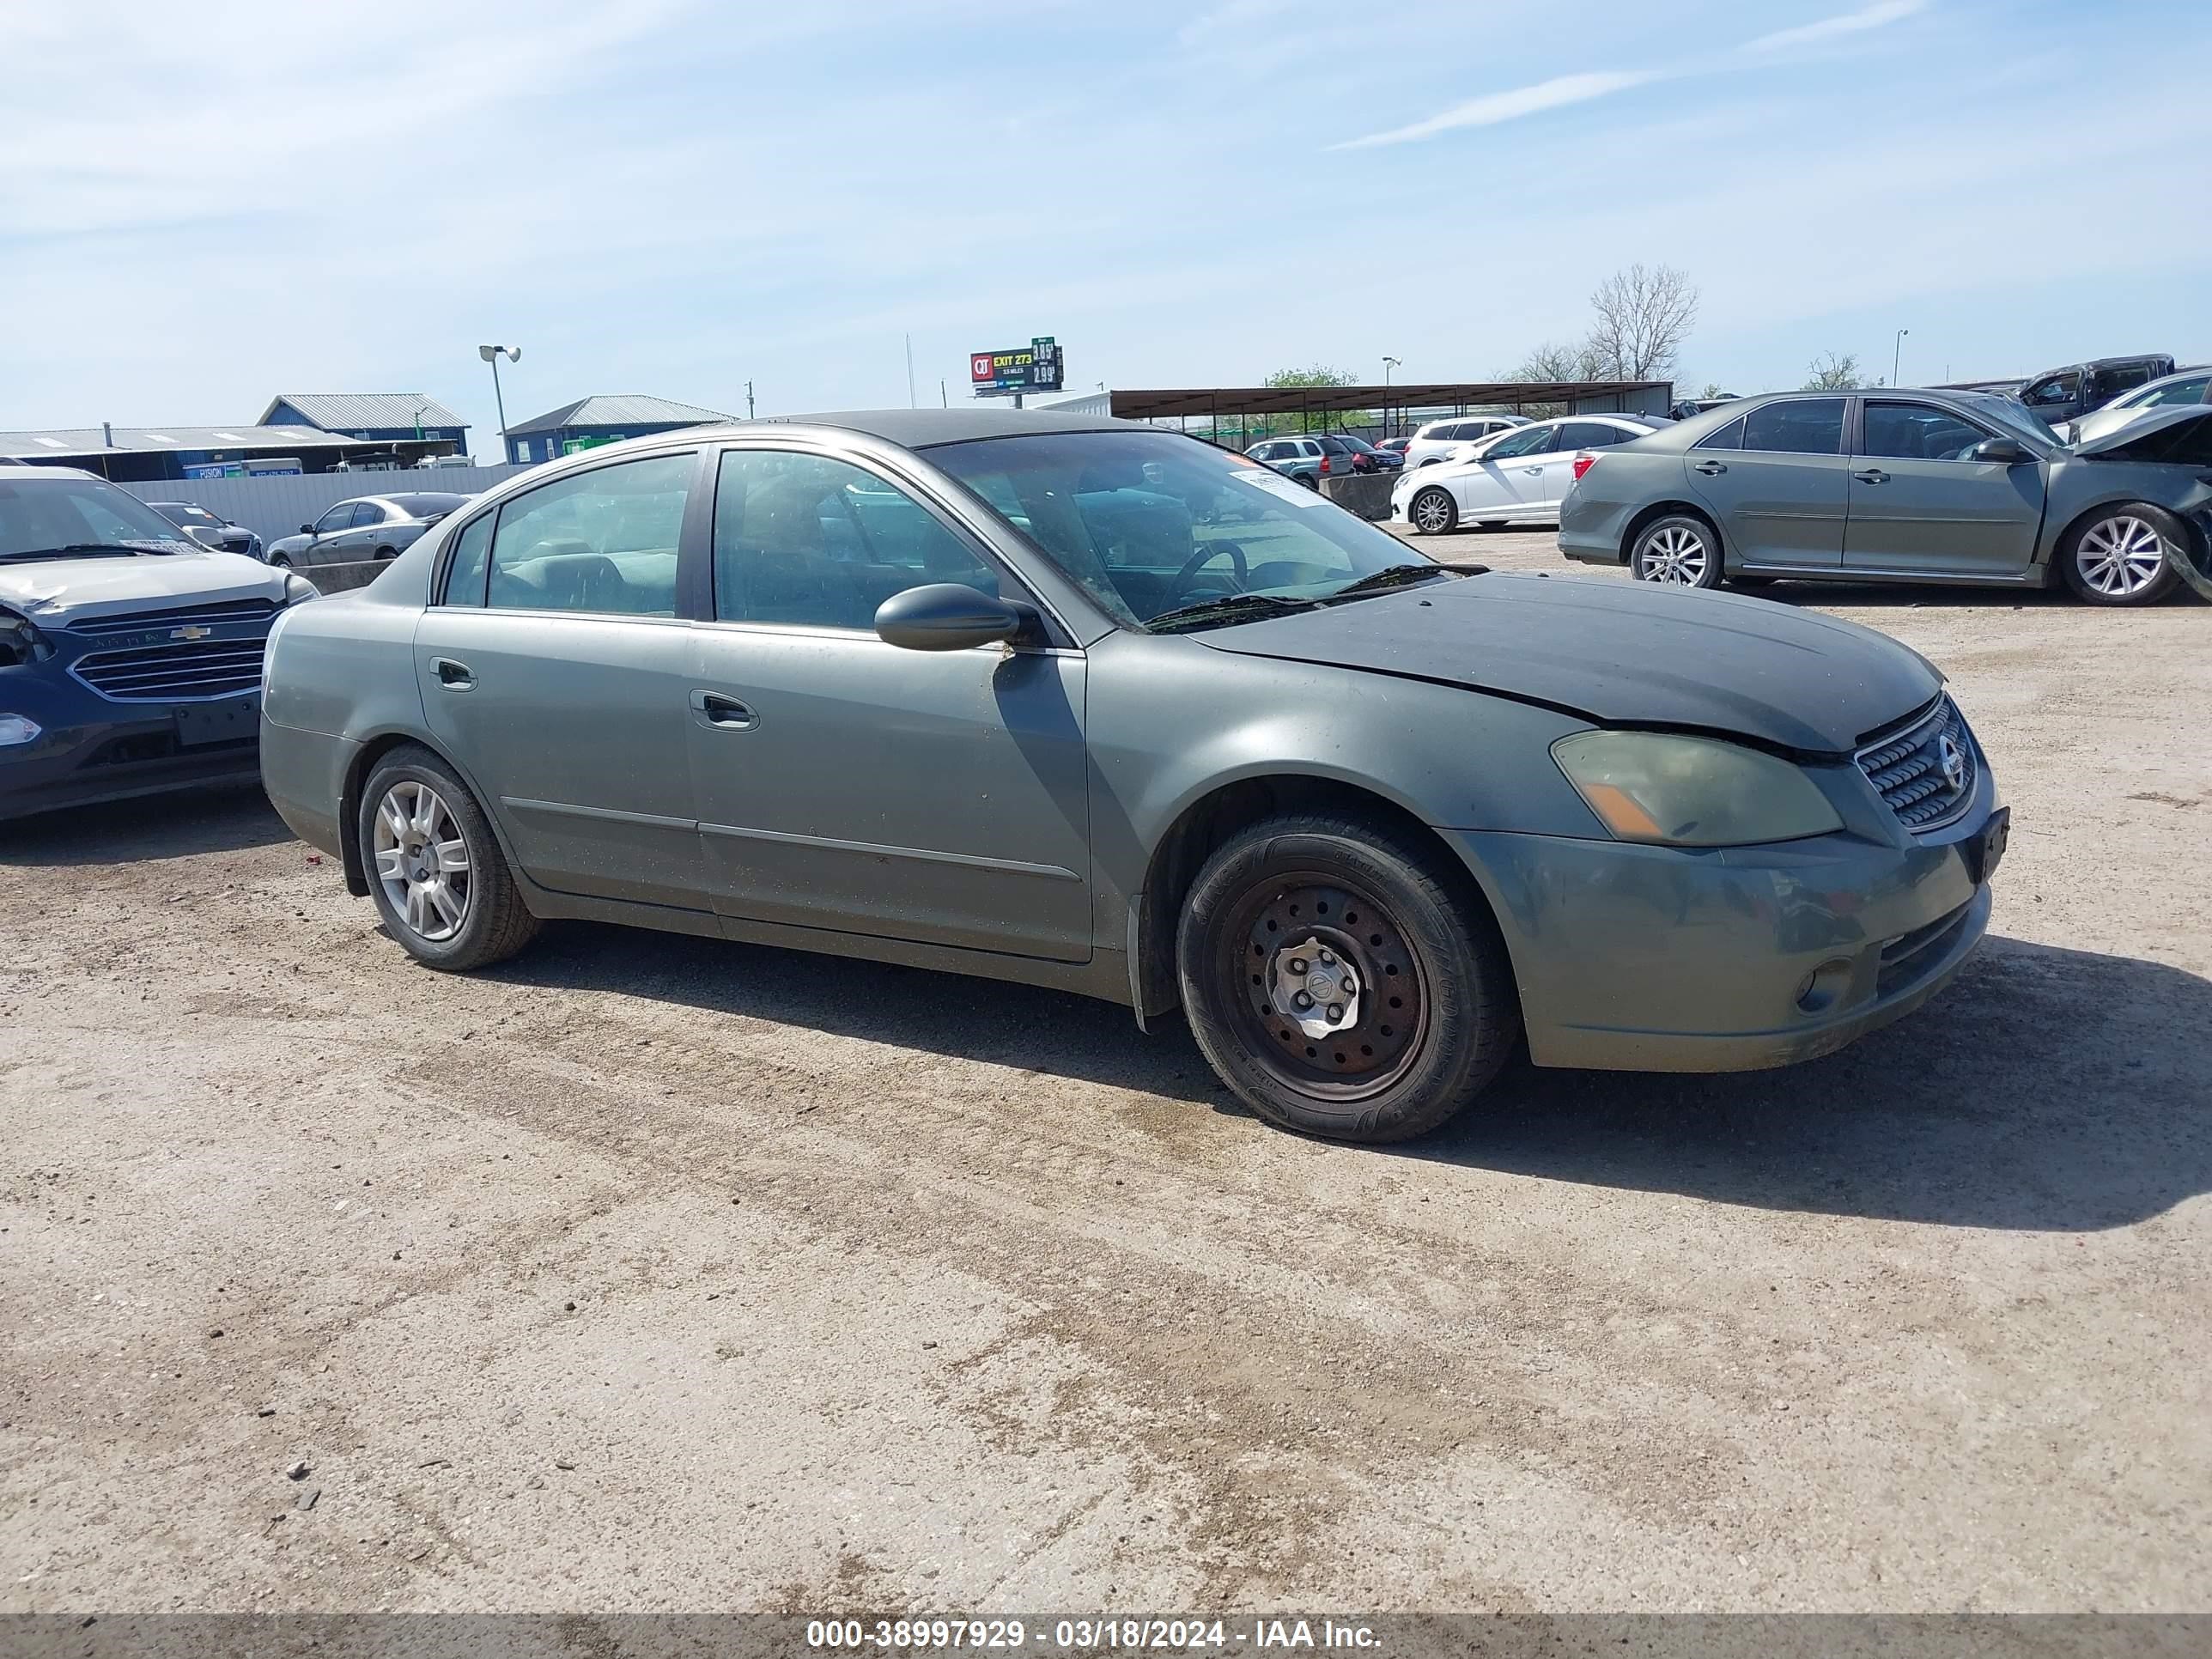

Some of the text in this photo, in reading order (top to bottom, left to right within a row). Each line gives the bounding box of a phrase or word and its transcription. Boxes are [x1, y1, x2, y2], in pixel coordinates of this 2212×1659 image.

[974, 359, 989, 376] QT
[994, 356, 1013, 368] EXIT
[1015, 354, 1032, 365] 273
[199, 467, 222, 478] FUSION
